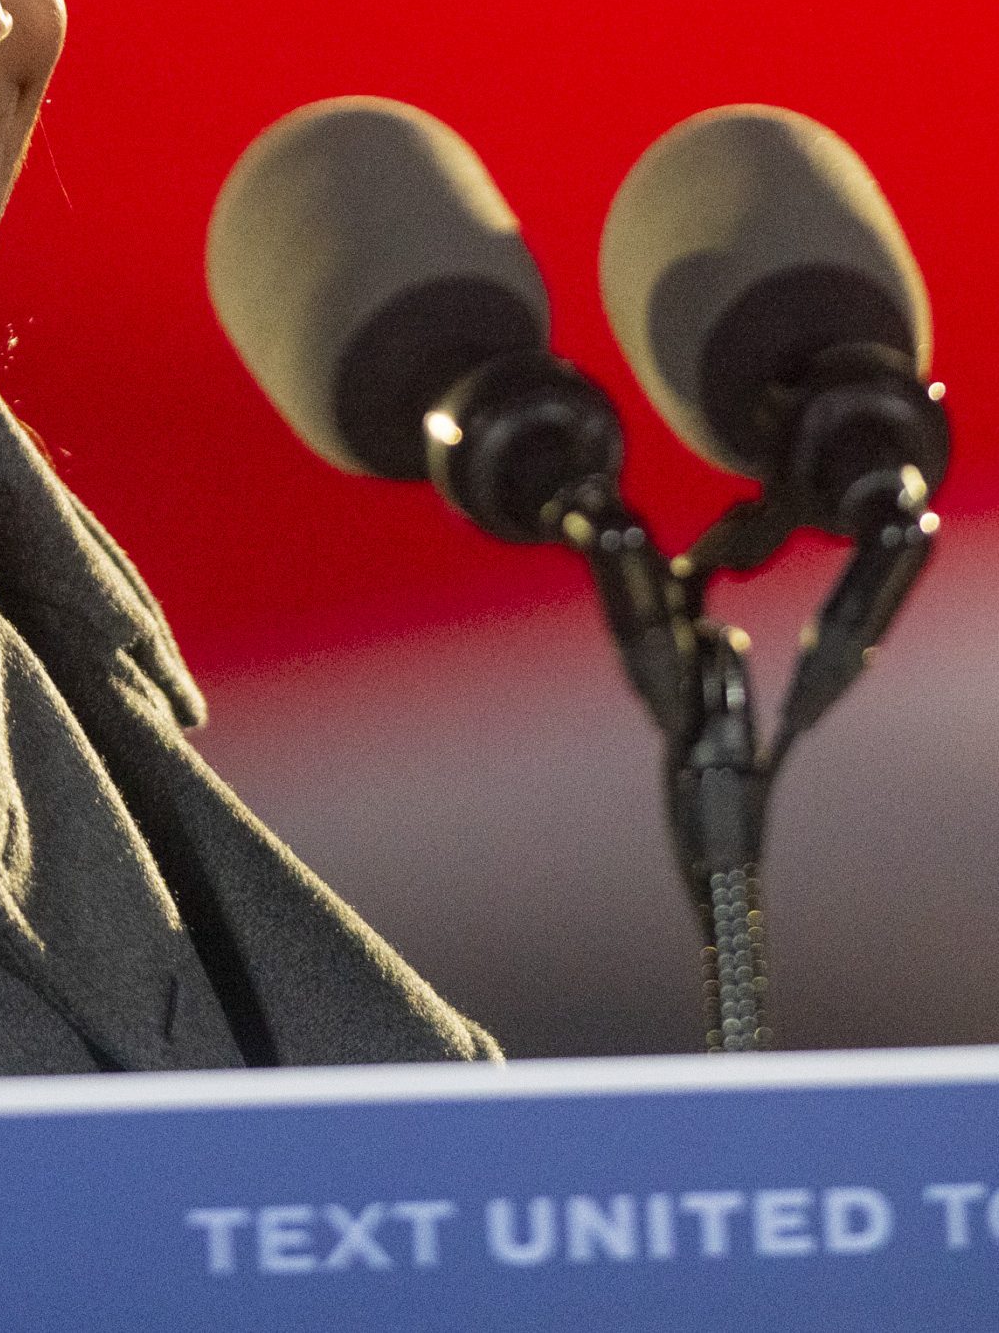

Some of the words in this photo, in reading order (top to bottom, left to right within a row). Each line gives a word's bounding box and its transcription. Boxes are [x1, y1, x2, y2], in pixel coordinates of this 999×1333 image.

[187, 1202, 456, 1272] TEXT
[485, 1186, 893, 1266] UNITED
[924, 1182, 999, 1248] T
